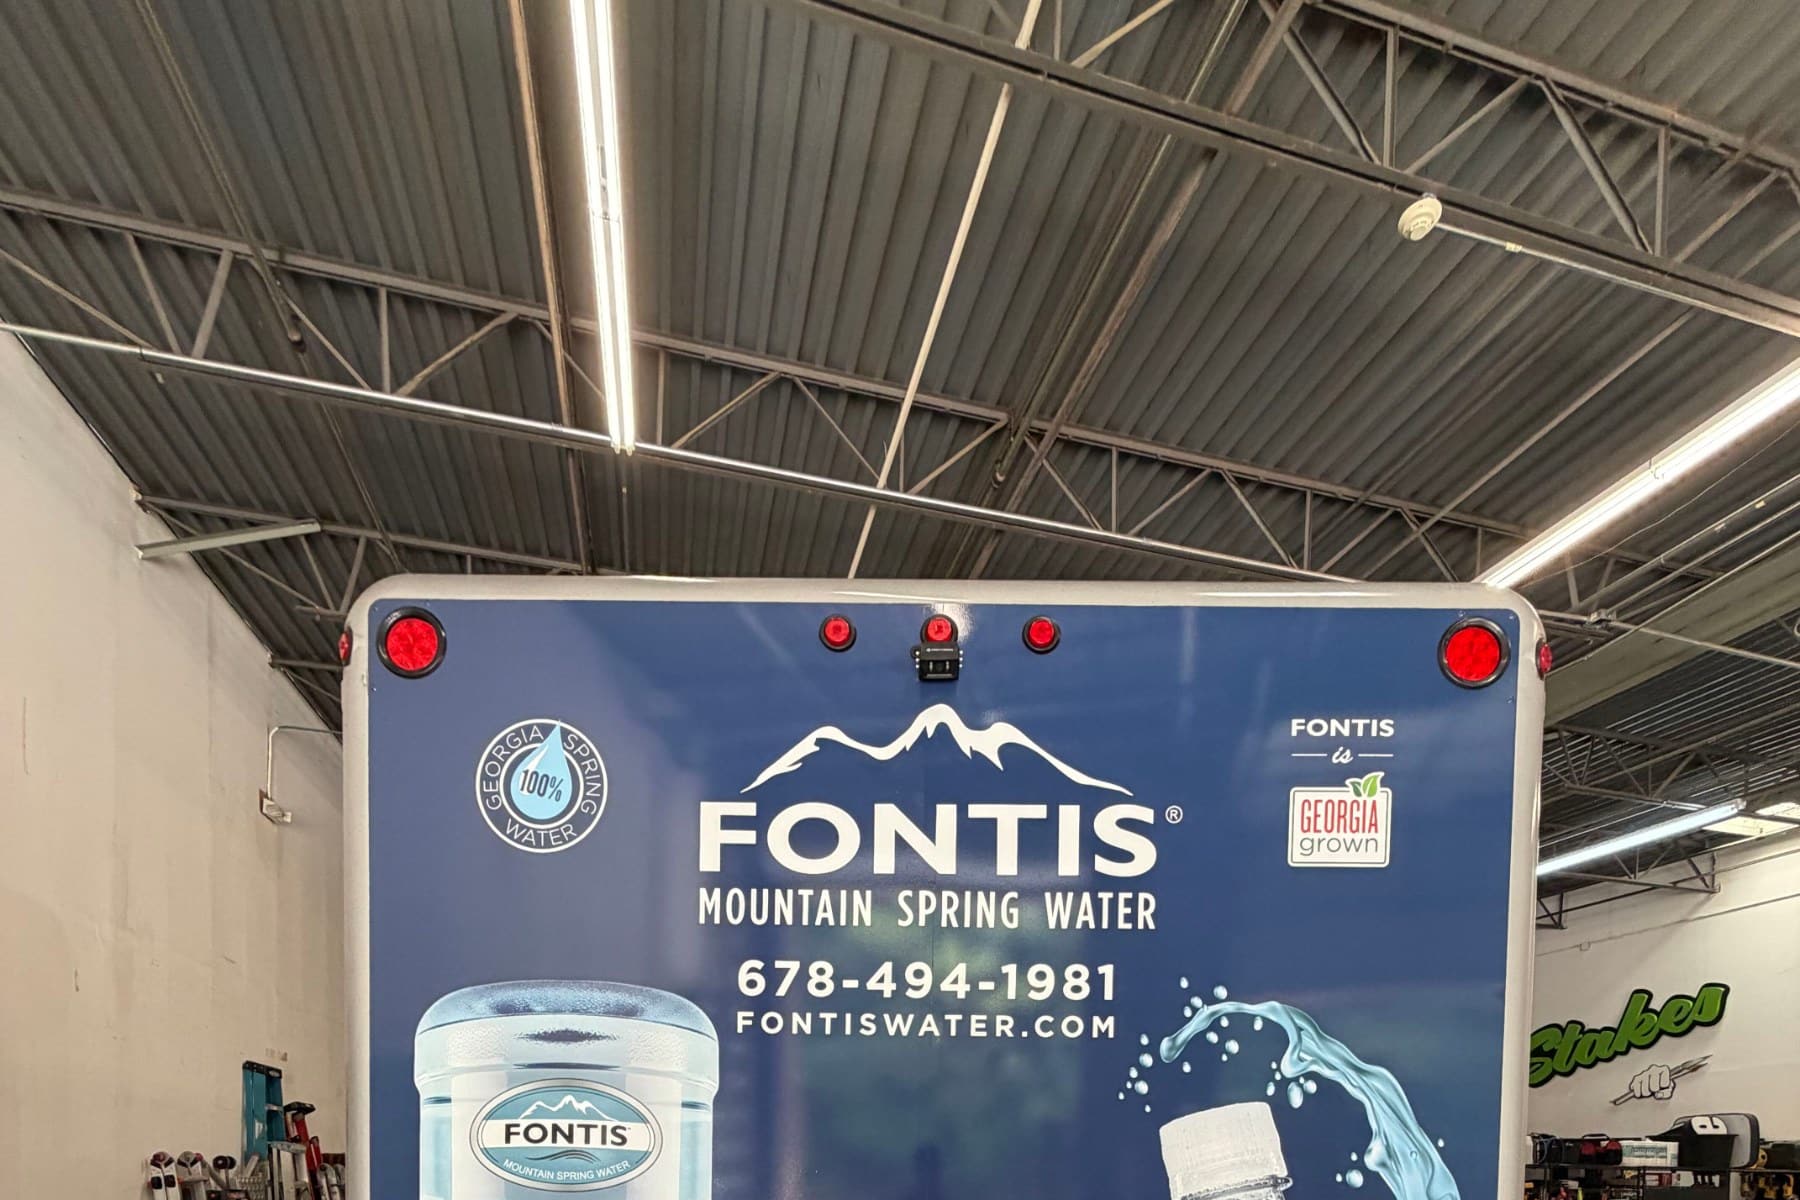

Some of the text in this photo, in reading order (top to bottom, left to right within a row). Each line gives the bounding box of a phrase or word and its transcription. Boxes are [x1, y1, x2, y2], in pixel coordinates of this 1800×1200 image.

[1291, 718, 1395, 737] FONTIS
[1332, 746, 1354, 764] is
[483, 725, 602, 815] GEORGIA SPRING
[520, 769, 564, 802] 100%
[1300, 799, 1379, 834] GEORGIA
[506, 818, 577, 847] WATER
[1299, 837, 1378, 857] grown
[698, 887, 1157, 931] MOUNTAIN SPRING WATER
[737, 959, 1116, 1001] 678-494-1981
[736, 1010, 1116, 1039] FONTISWATER.COM
[504, 1122, 628, 1147] FONTIS
[503, 1159, 631, 1181] MOUNTAIN SPRING WATER
